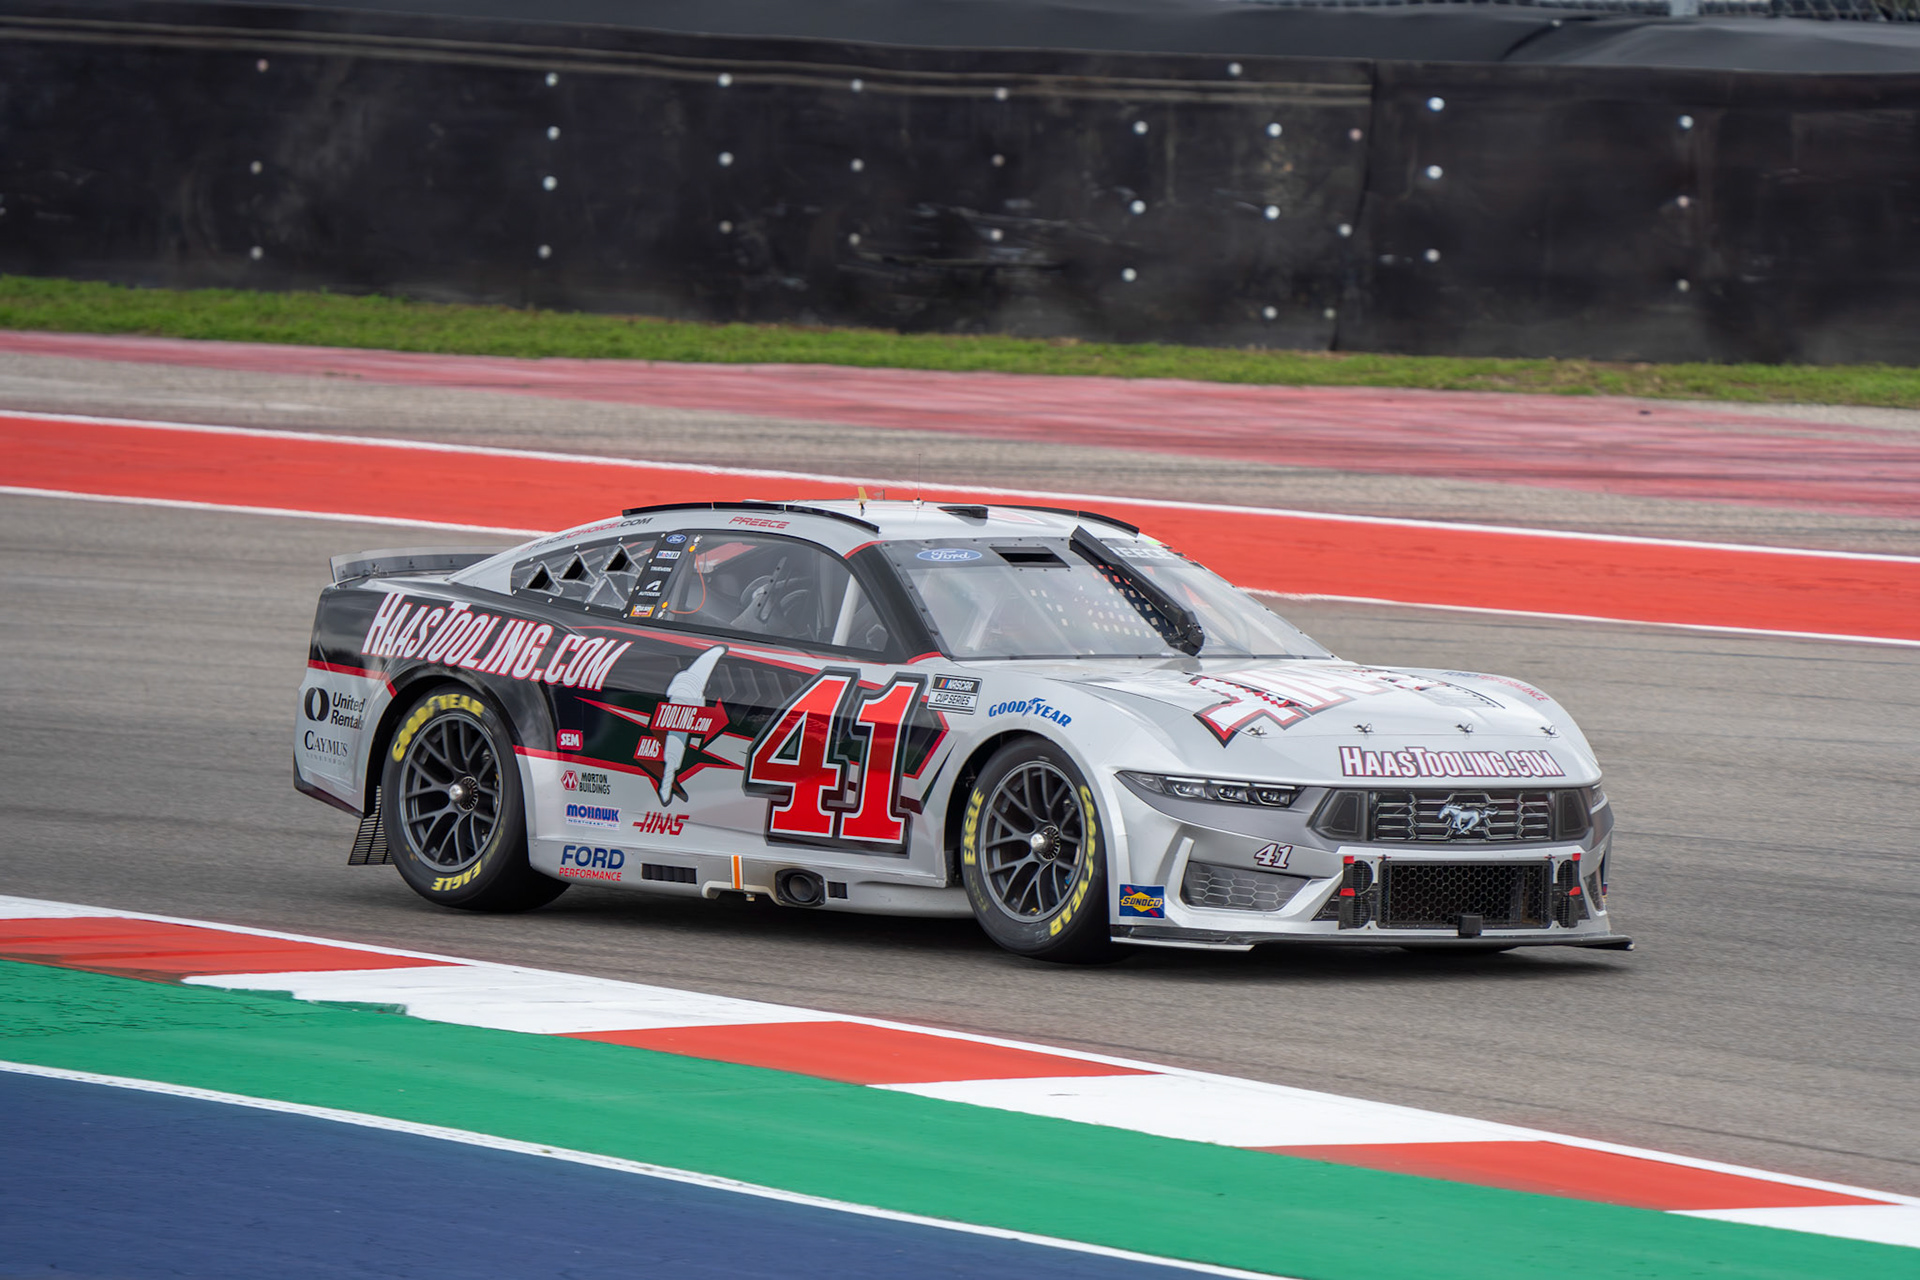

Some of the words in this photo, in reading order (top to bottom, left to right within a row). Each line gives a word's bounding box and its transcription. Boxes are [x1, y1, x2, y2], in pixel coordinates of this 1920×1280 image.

[728, 516, 791, 529] PREECE
[945, 679, 975, 692] NASCAR
[332, 691, 366, 713] United
[934, 693, 949, 704] CUP
[949, 694, 971, 706] SERIES
[330, 709, 364, 731] Rentals
[988, 697, 1072, 728] GOODYEAR
[560, 733, 580, 747] SEM
[637, 738, 661, 758] HAAS
[745, 670, 923, 852] 41
[581, 772, 608, 784] MORTON
[578, 782, 611, 795] BUILDINGS
[566, 804, 620, 823] MOHAWK
[632, 811, 690, 836] HAAS
[964, 787, 985, 865] EAGLE
[560, 845, 625, 870] FORD
[1254, 843, 1293, 869] 41
[401, 860, 482, 891] EAGLE
[558, 867, 622, 882] PERFORMANCE
[1122, 897, 1162, 909] SUNOCO
